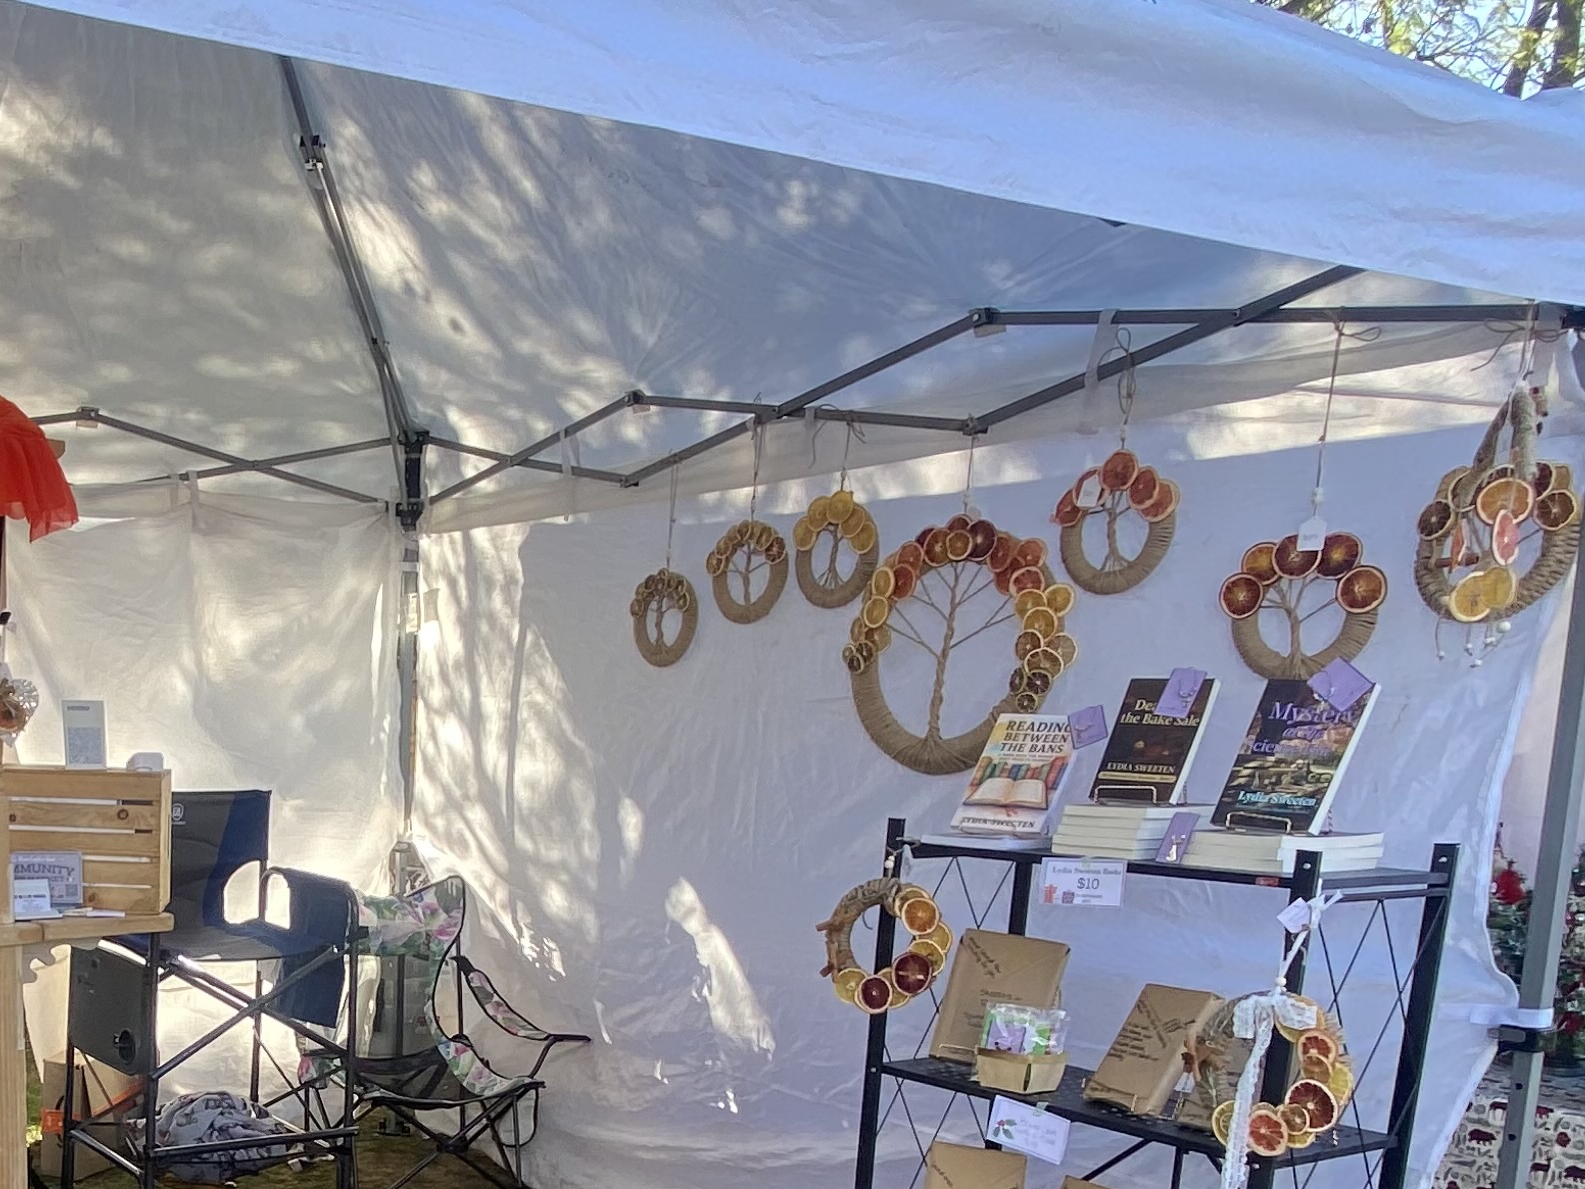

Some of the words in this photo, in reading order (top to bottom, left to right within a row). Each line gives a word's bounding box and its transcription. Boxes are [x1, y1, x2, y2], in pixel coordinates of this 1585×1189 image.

[1120, 712, 1140, 724] the
[1142, 713, 1172, 726] Bake
[1173, 715, 1200, 727] Sale
[1003, 732, 1070, 744] BETWEEN
[1000, 743, 1025, 753] THE
[1029, 743, 1065, 754] BANS
[1106, 761, 1132, 772] LYDIA
[1134, 763, 1176, 774] SWEETEN
[14, 863, 75, 877] MMUNITY
[1076, 877, 1100, 890] $10
